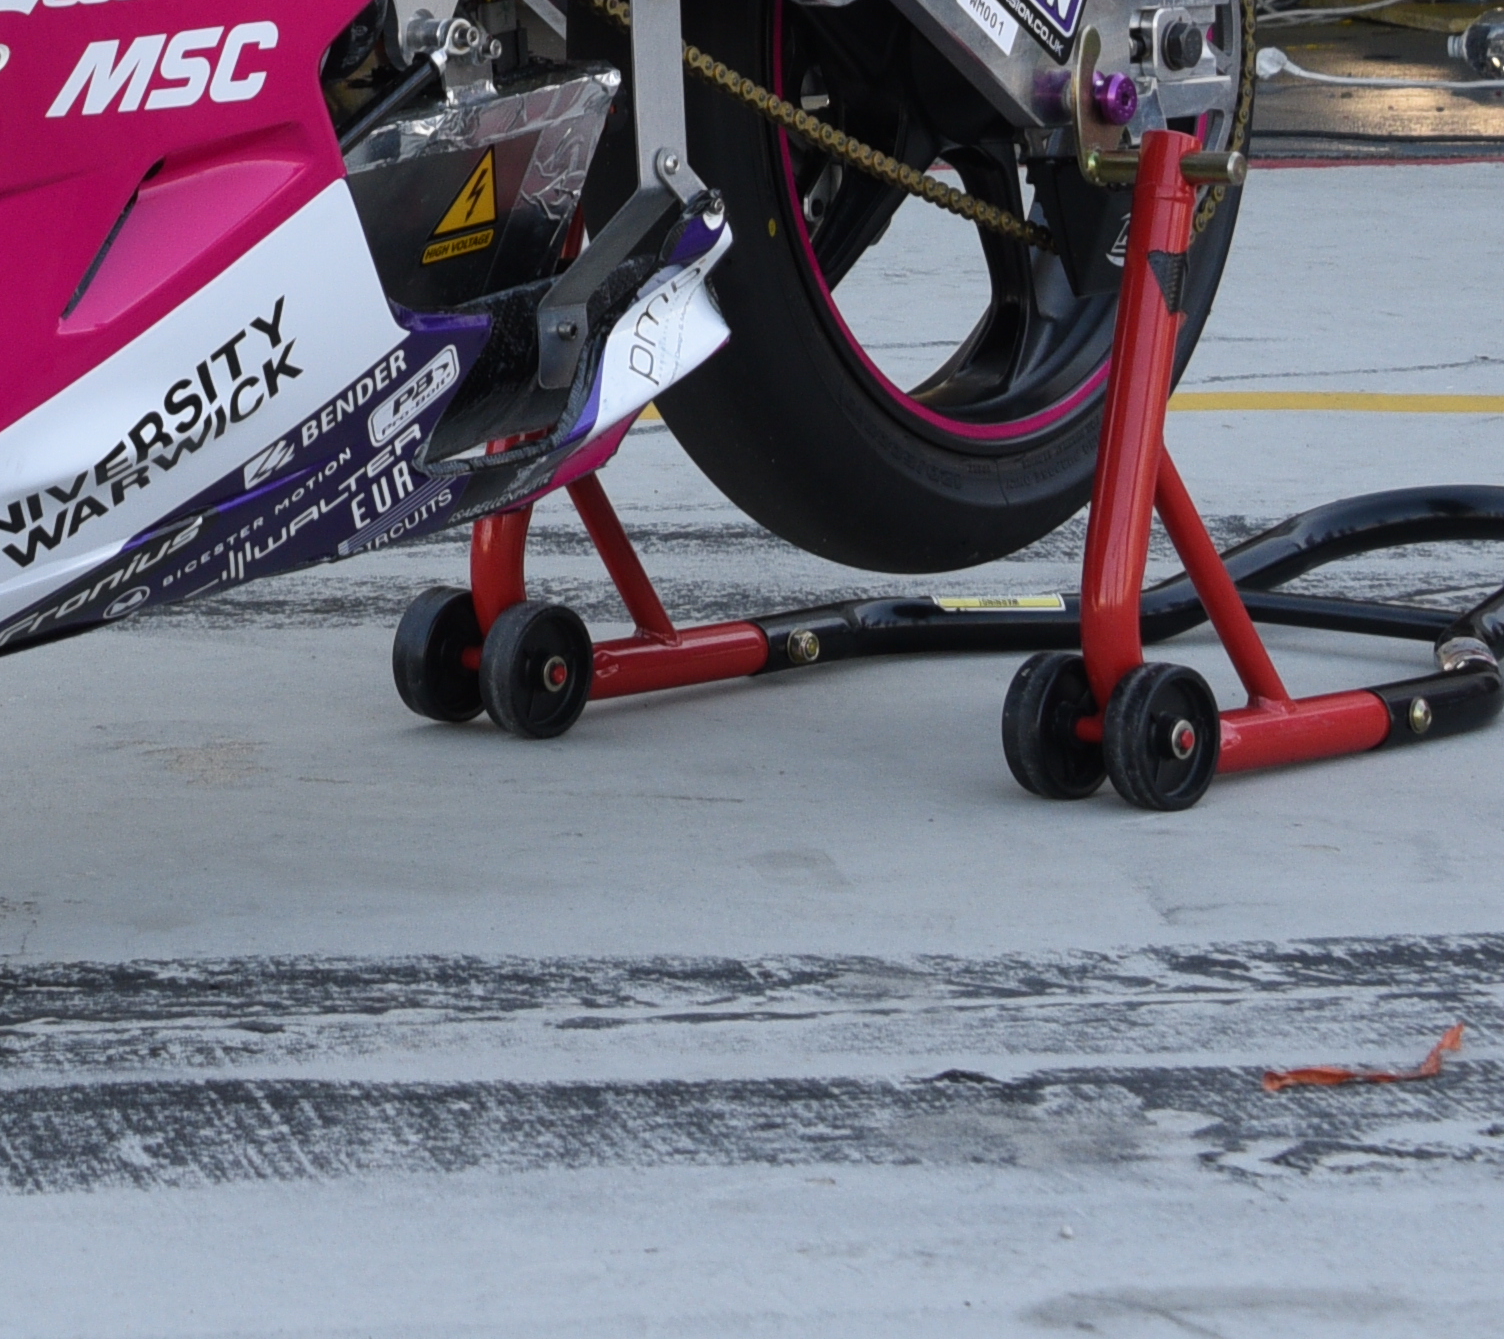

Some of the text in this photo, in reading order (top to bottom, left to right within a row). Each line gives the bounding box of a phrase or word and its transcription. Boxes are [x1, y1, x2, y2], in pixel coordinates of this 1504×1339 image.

[45, 20, 278, 119] MSC
[424, 233, 491, 260] HIGH VOLTAGE
[2, 337, 304, 568] WARWICK
[302, 348, 407, 446] BENDER
[162, 448, 352, 588] BICESTER MOTION
[253, 424, 422, 559] WALTER
